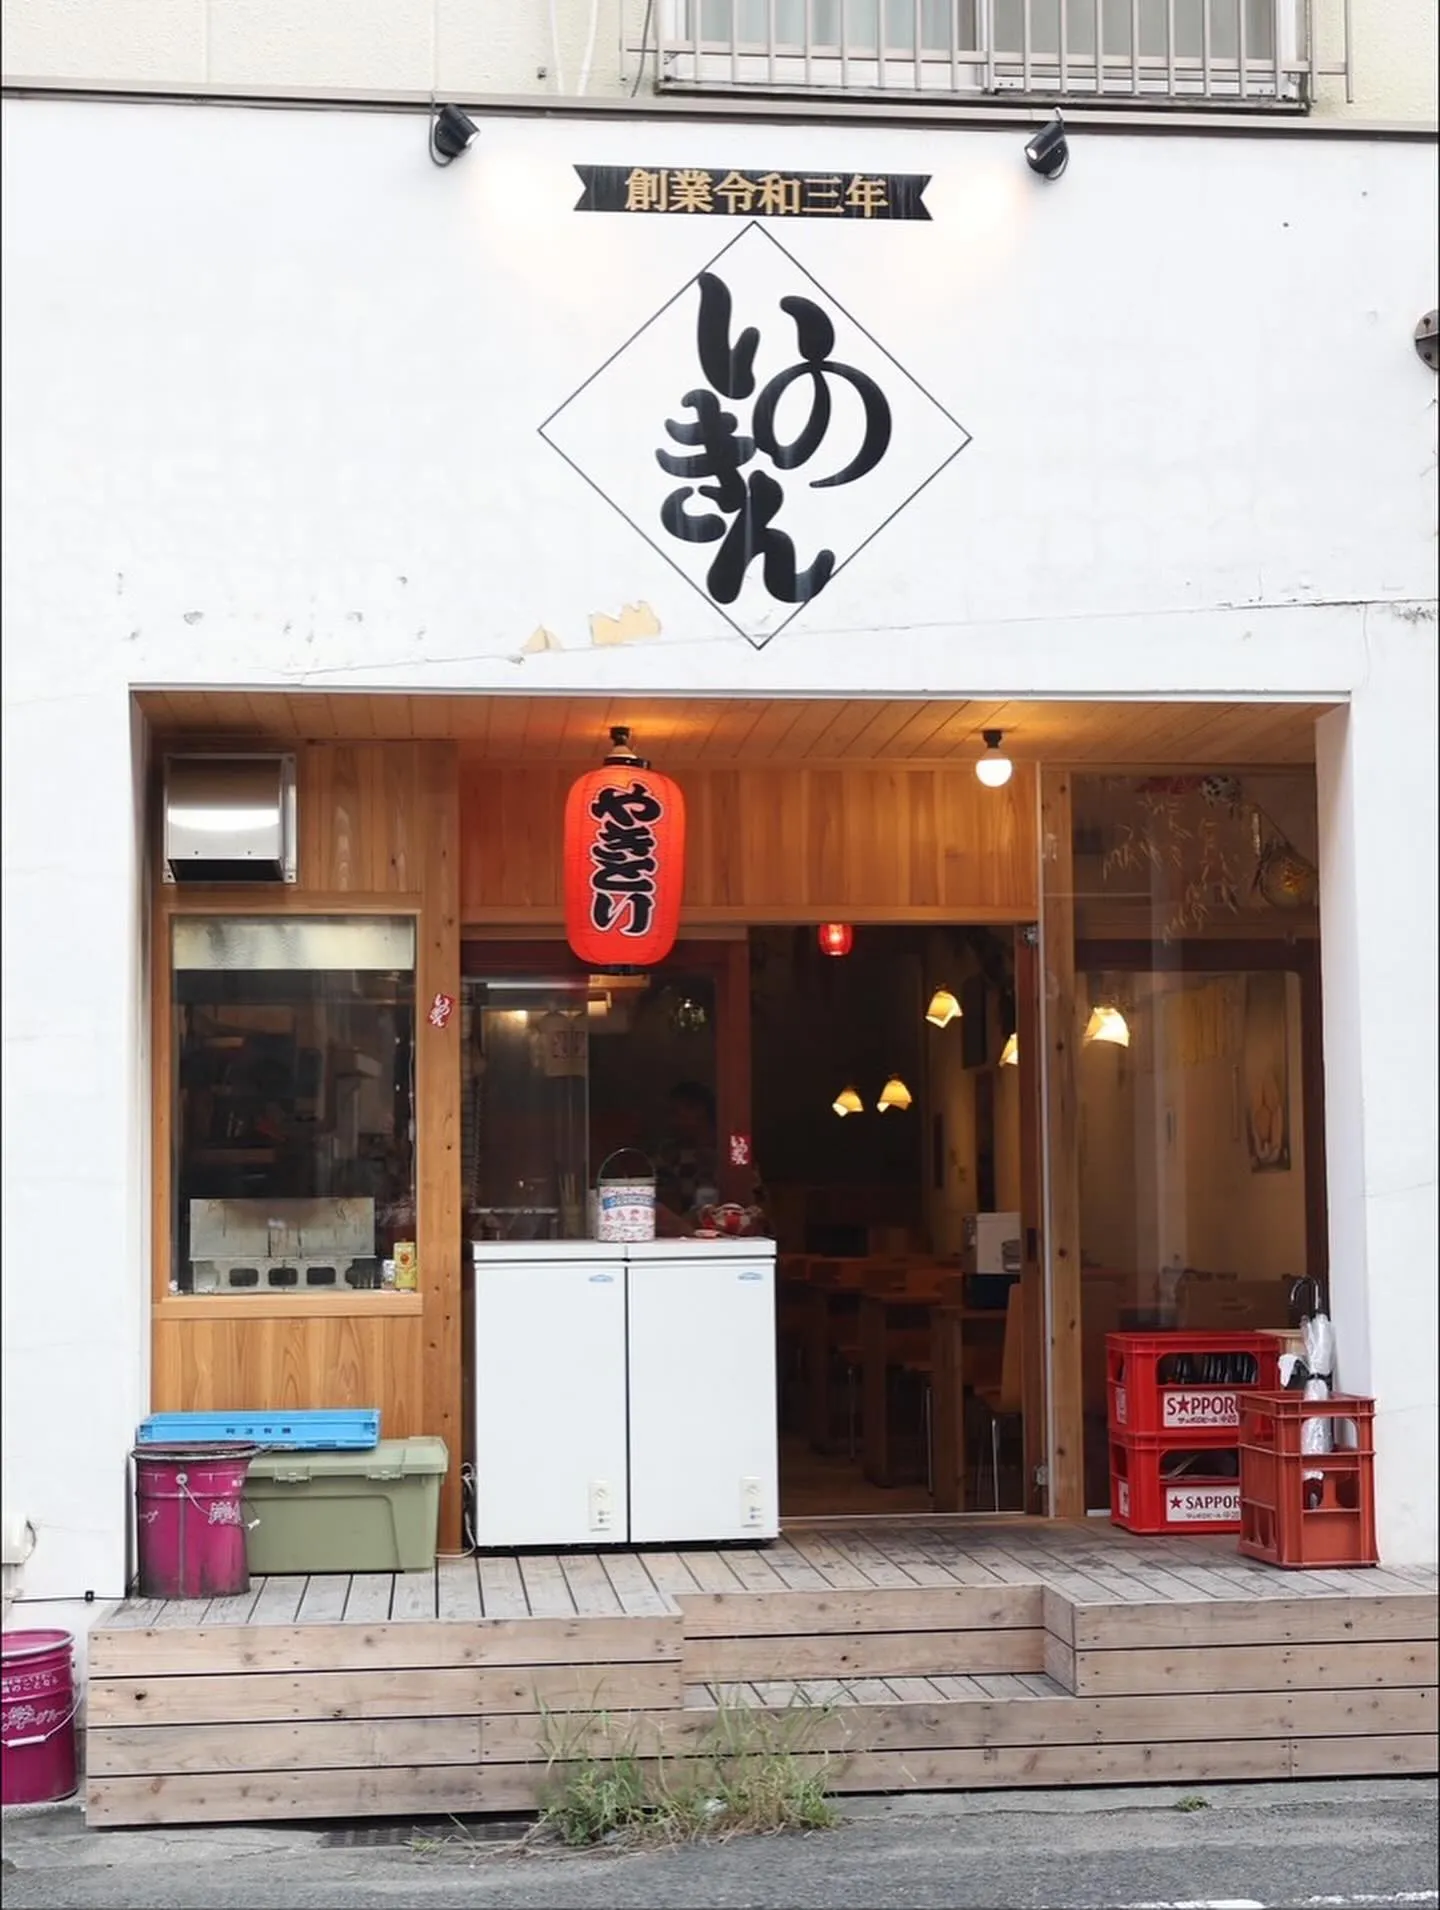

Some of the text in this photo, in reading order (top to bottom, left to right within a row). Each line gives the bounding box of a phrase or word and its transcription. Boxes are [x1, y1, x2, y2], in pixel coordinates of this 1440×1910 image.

[624, 167, 889, 218] 創業令和三年
[654, 271, 892, 604] いのきん
[588, 780, 664, 936] やきとり
[1185, 1495, 1241, 1510] SAPPOR
